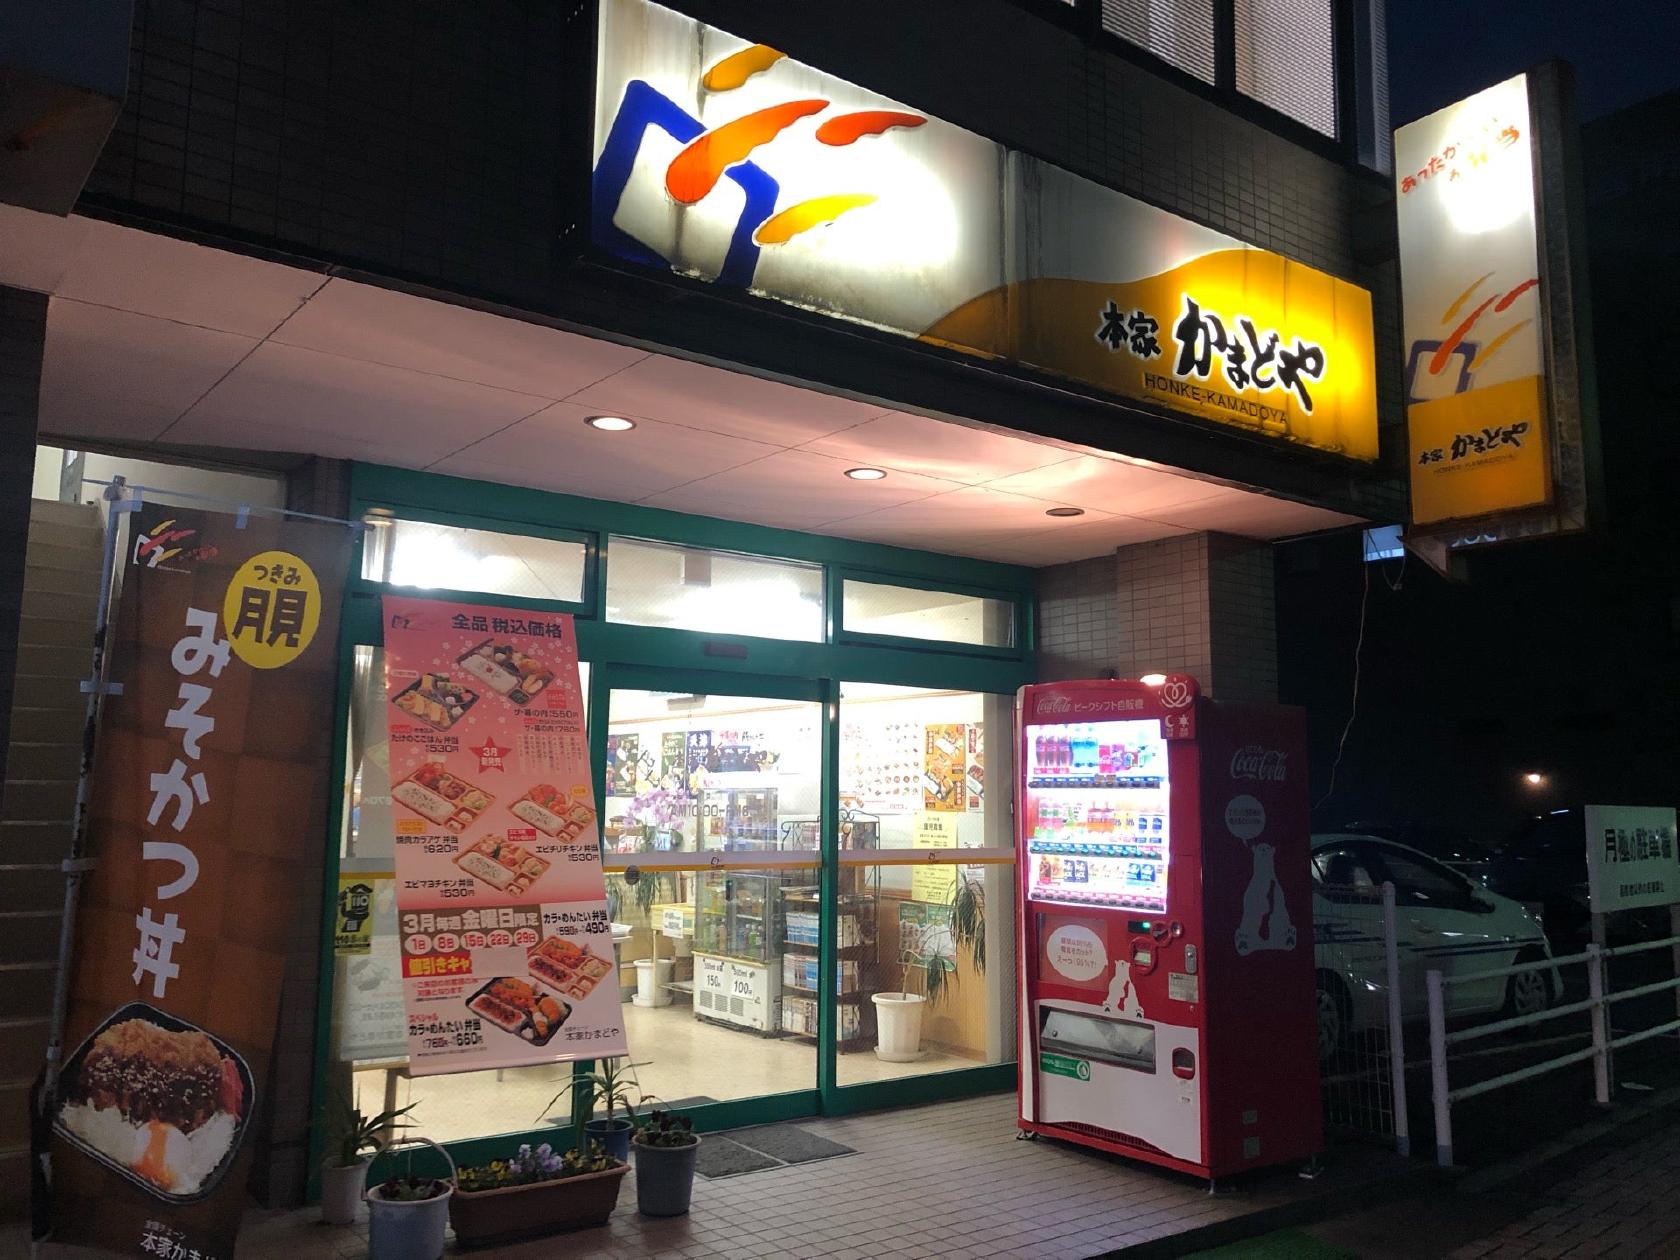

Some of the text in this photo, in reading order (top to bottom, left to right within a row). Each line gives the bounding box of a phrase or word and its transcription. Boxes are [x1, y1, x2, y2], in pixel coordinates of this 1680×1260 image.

[1096, 292, 1326, 414] 本家 かまどや
[1144, 374, 1287, 424] HONKE-KAMADOYA
[1450, 422, 1529, 461] かまどや
[253, 563, 302, 585] つきみ
[451, 613, 562, 639] 全品 税込価格
[132, 607, 231, 999] みそかつ丼
[411, 937, 427, 950] 1日
[437, 936, 455, 948] 8日
[464, 935, 485, 947] 15日
[490, 934, 510, 945] 22日
